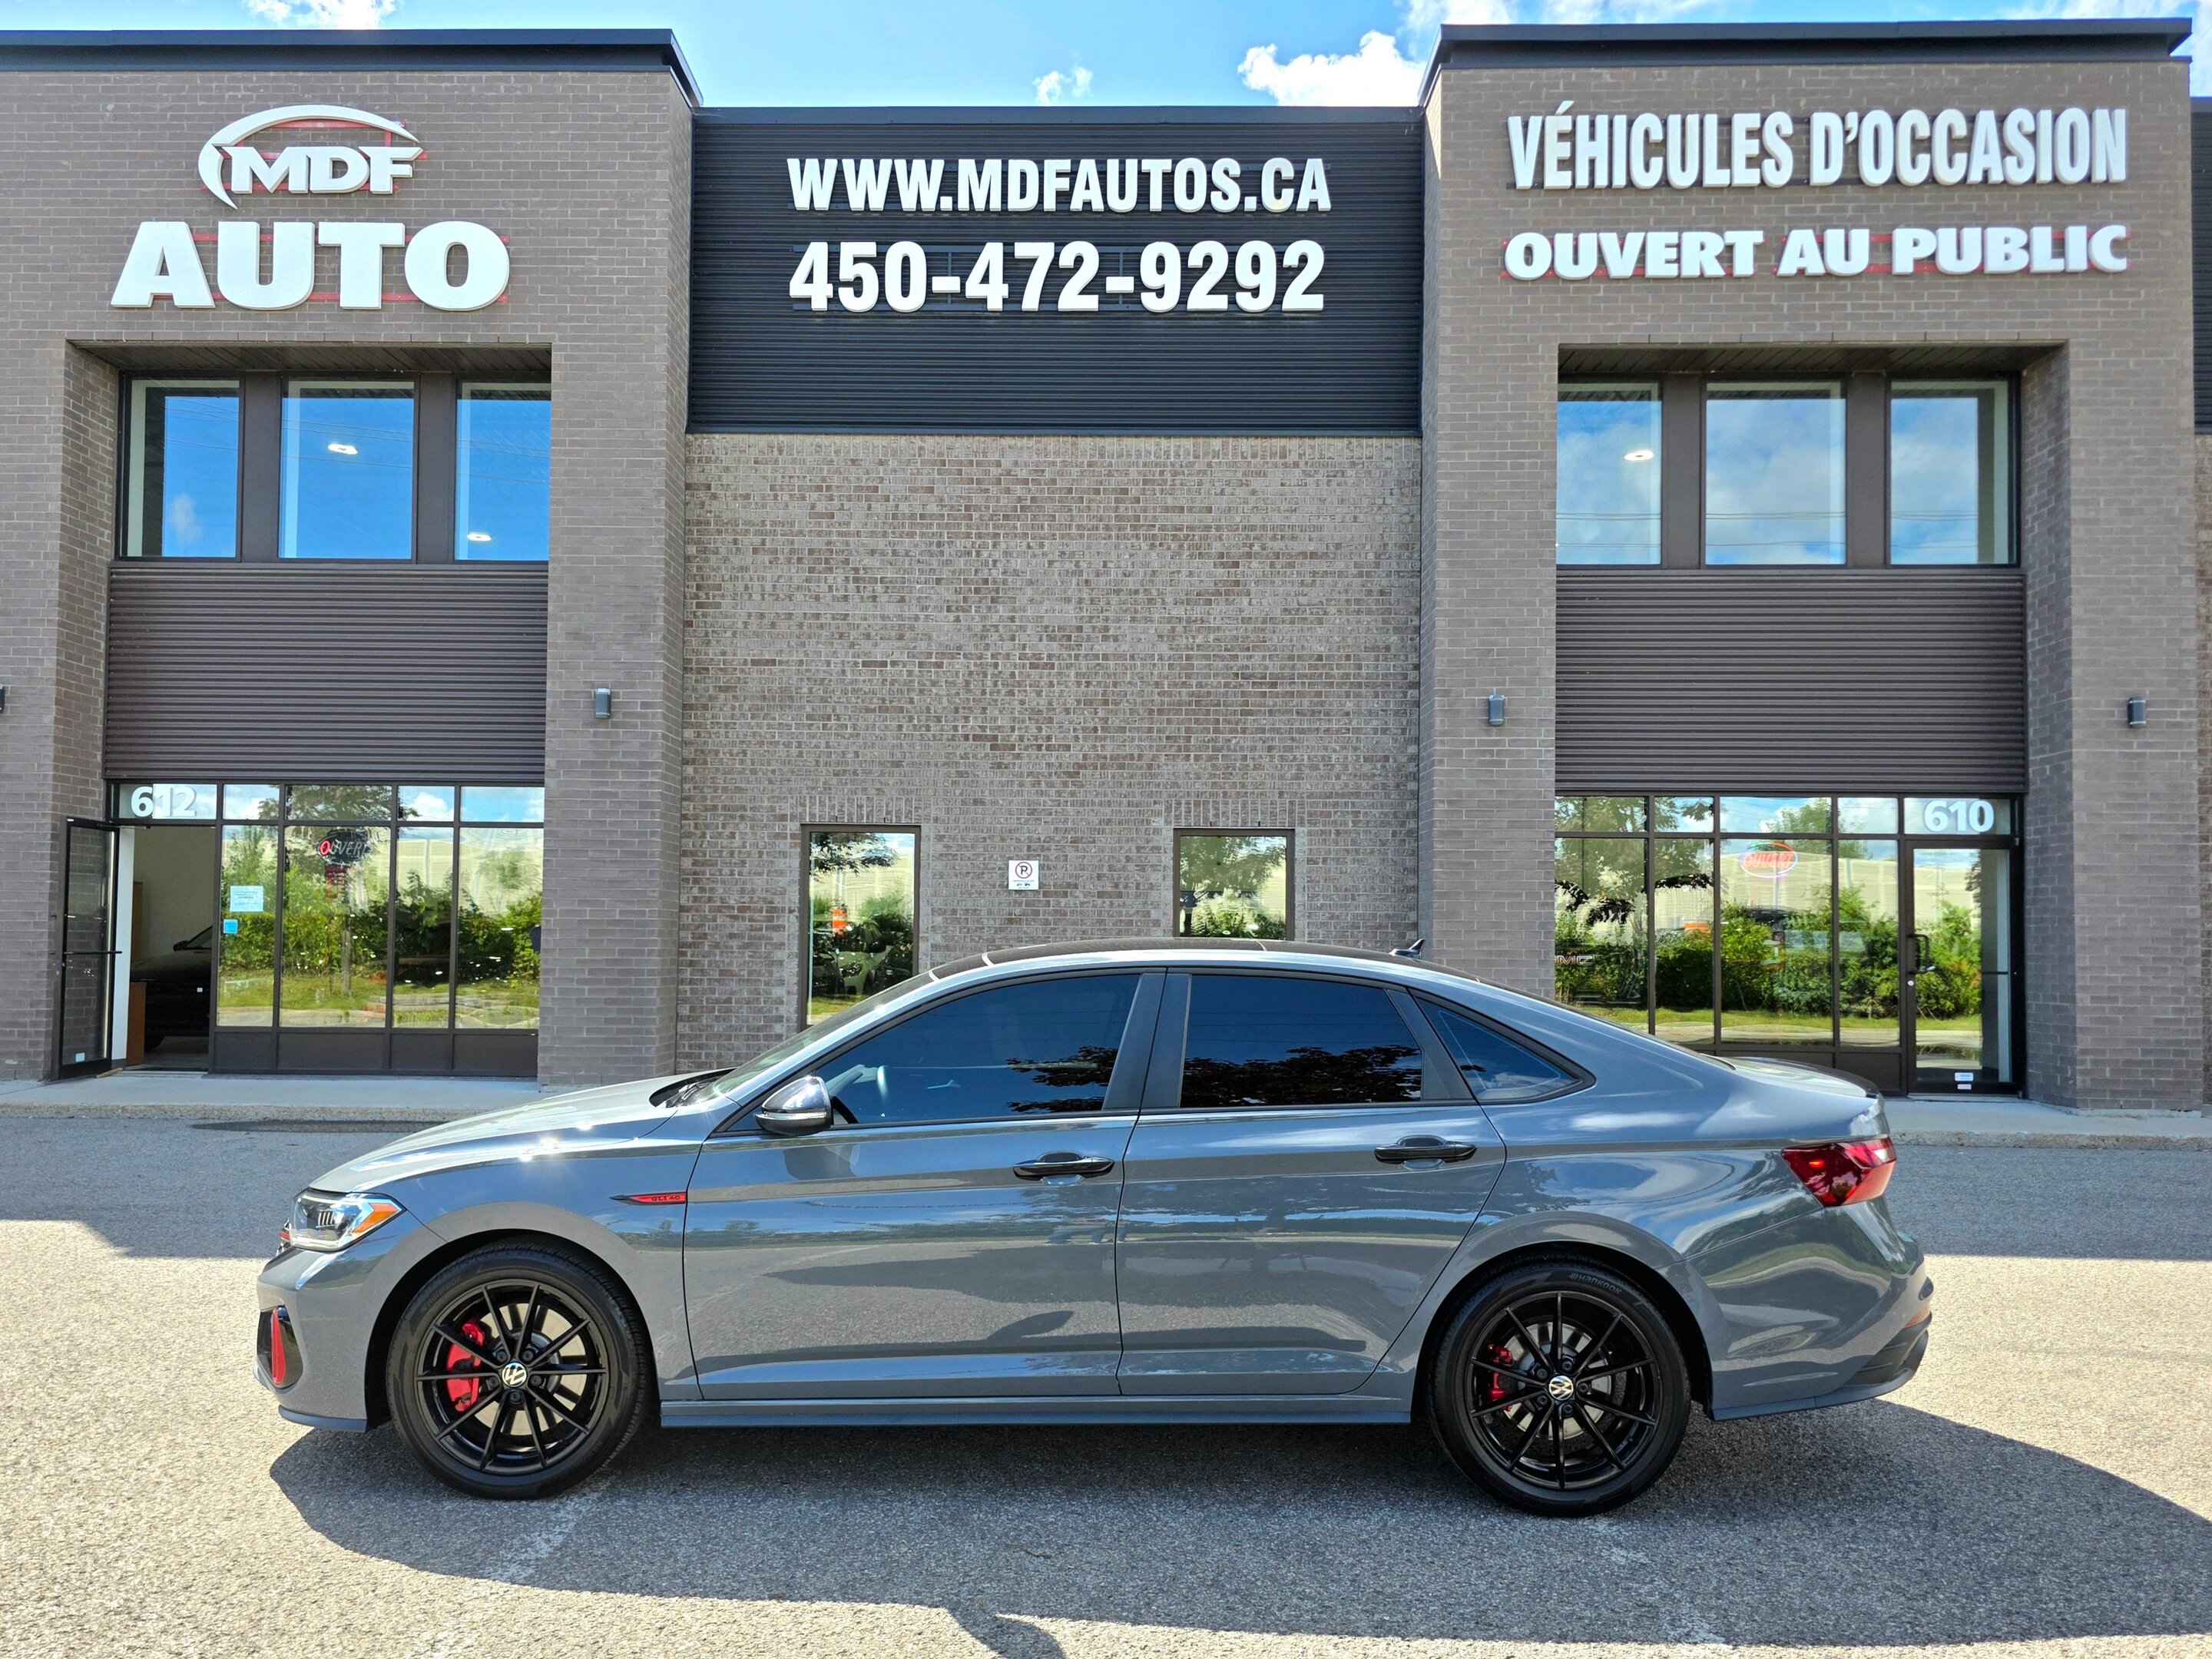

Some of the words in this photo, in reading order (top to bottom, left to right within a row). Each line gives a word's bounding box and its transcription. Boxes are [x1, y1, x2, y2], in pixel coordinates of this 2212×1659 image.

[220, 145, 424, 195] MDF
[1508, 101, 1793, 190] VÉHICULES
[1810, 108, 2127, 187] D'OCCASION
[786, 157, 1333, 213] WWW.MDFAUTOS.CA
[110, 220, 511, 311] AUTO
[789, 240, 1326, 313] 450-472-9292
[1504, 230, 1765, 280] OUVERT
[1776, 228, 1871, 276] AU
[1892, 224, 2128, 274] PUBLIC
[131, 786, 197, 817] 612
[1924, 800, 1995, 833] 610
[1555, 955, 1593, 966] MC
